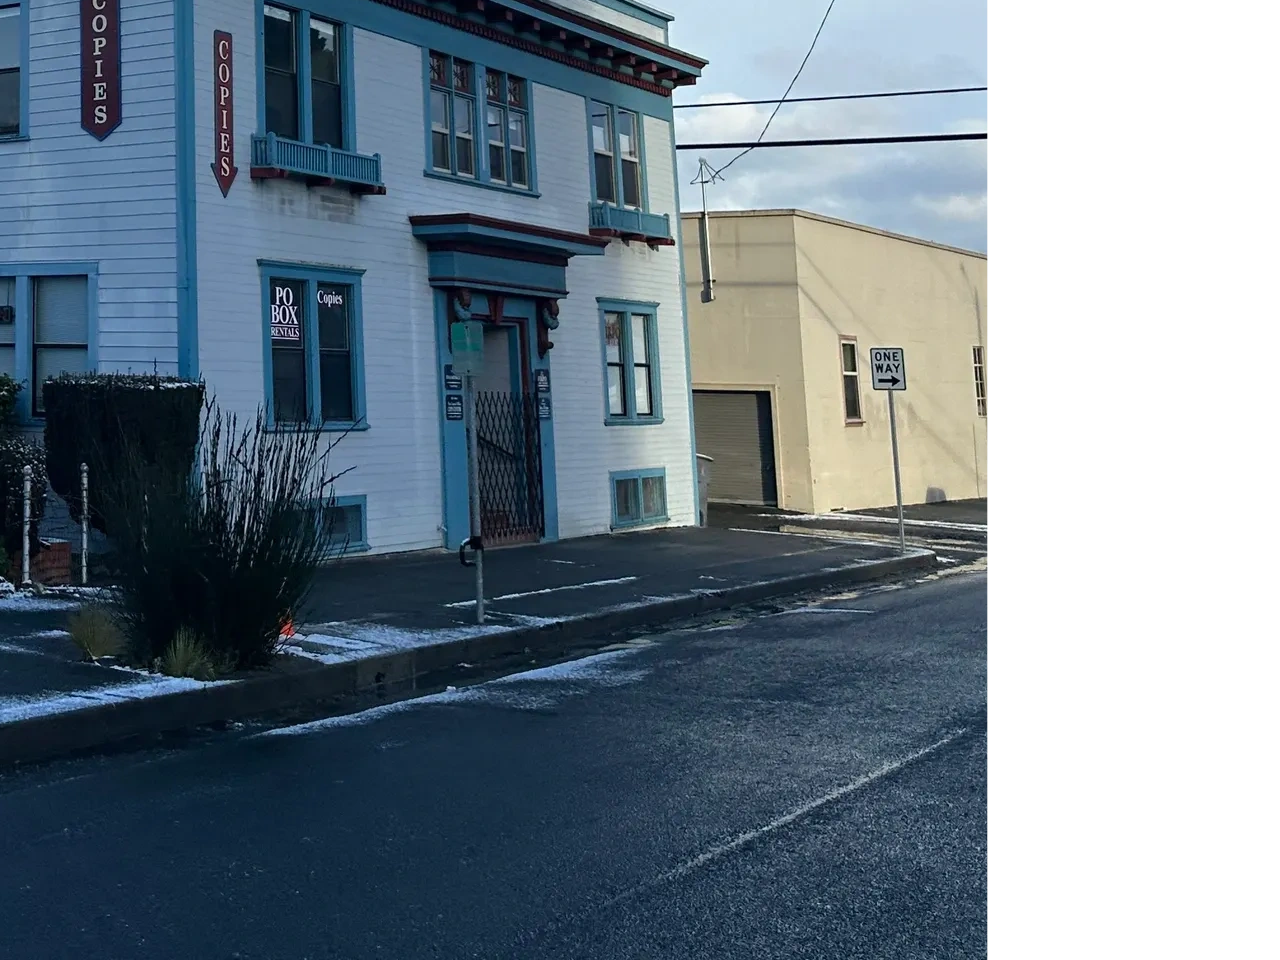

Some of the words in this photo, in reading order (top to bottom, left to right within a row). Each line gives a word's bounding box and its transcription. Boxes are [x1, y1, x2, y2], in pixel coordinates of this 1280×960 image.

[218, 40, 231, 177] COPIES
[275, 286, 294, 306] PO
[317, 289, 343, 308] Copies
[271, 304, 299, 325] BOX
[270, 326, 300, 338] RENTALS
[874, 351, 900, 362] ONE
[874, 363, 900, 374] WAY
